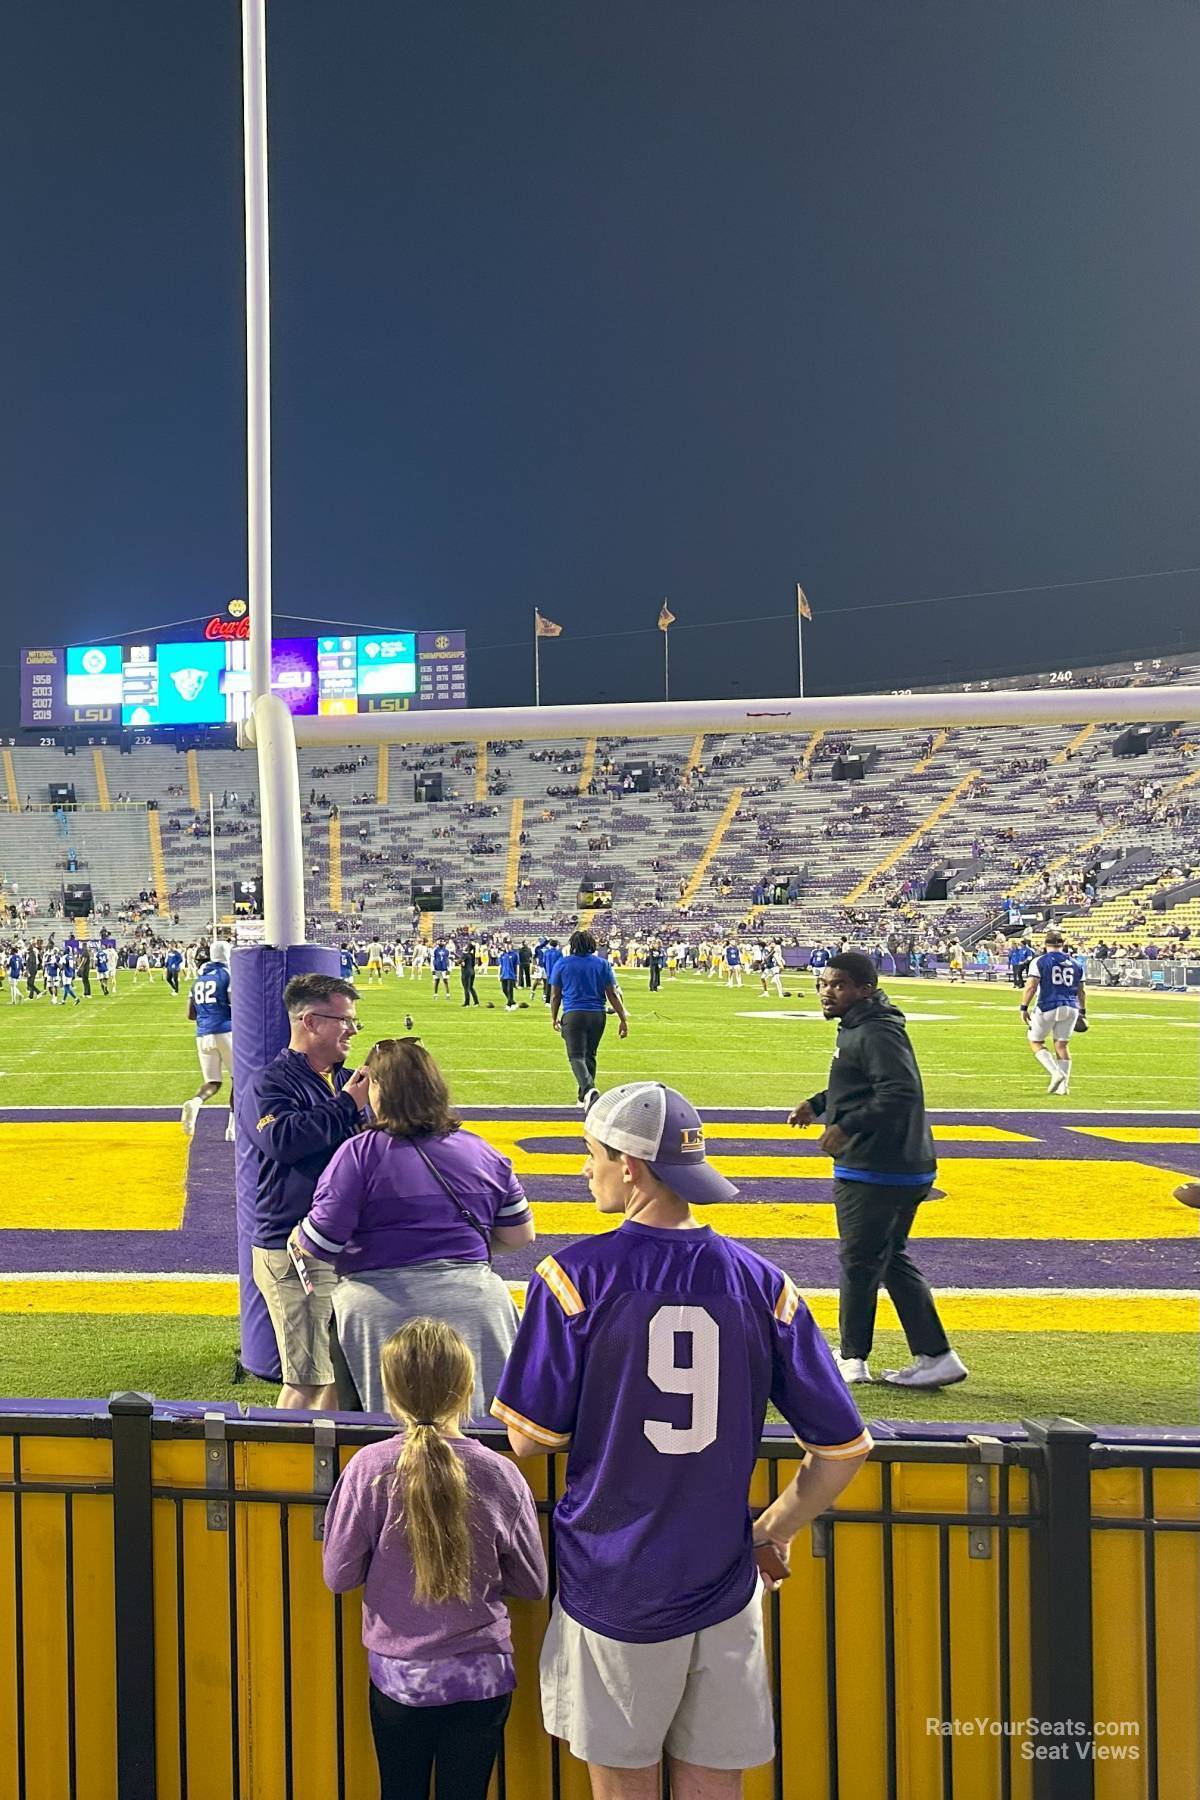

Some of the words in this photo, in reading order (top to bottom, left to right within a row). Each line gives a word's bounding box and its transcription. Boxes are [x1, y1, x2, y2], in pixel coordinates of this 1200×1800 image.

[32, 674, 51, 685] 1958
[1050, 671, 1073, 683] 240
[32, 686, 53, 697] 2003
[32, 698, 52, 708] 2007
[368, 699, 409, 712] LSU
[33, 710, 52, 720] 2019
[74, 708, 112, 722] LSU
[40, 738, 56, 746] 231
[135, 736, 152, 745] 232
[240, 881, 257, 893] 25
[1052, 965, 1075, 987] 66
[194, 981, 217, 1004] 82
[643, 1305, 720, 1454] 9
